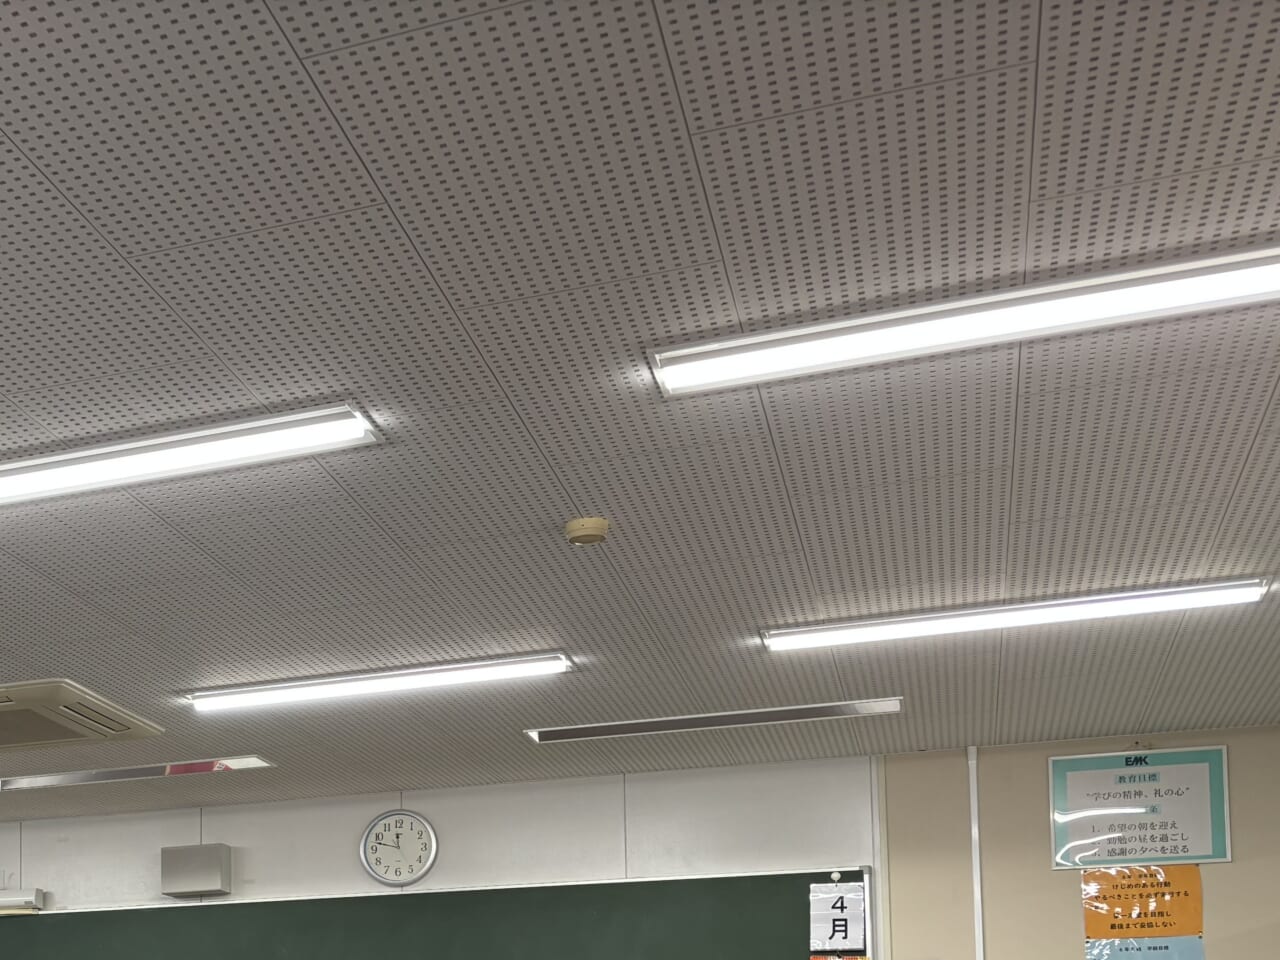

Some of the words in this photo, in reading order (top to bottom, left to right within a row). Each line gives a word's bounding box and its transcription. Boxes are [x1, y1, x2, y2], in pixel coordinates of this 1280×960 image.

[1118, 774, 1158, 784] 教育目標
[384, 823, 390, 832] 11
[395, 819, 403, 828] 12
[410, 822, 413, 831] 1
[1108, 822, 1178, 833] 希望の朝を迎え
[375, 832, 383, 841] 10
[418, 831, 423, 839] 2
[371, 845, 377, 854] 9
[421, 842, 427, 851] 3
[1107, 846, 1189, 857] 感謝の夕べを送る
[375, 857, 381, 866] 8
[416, 855, 421, 863] 4
[384, 866, 390, 874] 7
[395, 868, 401, 876] 6
[408, 865, 413, 873] 5
